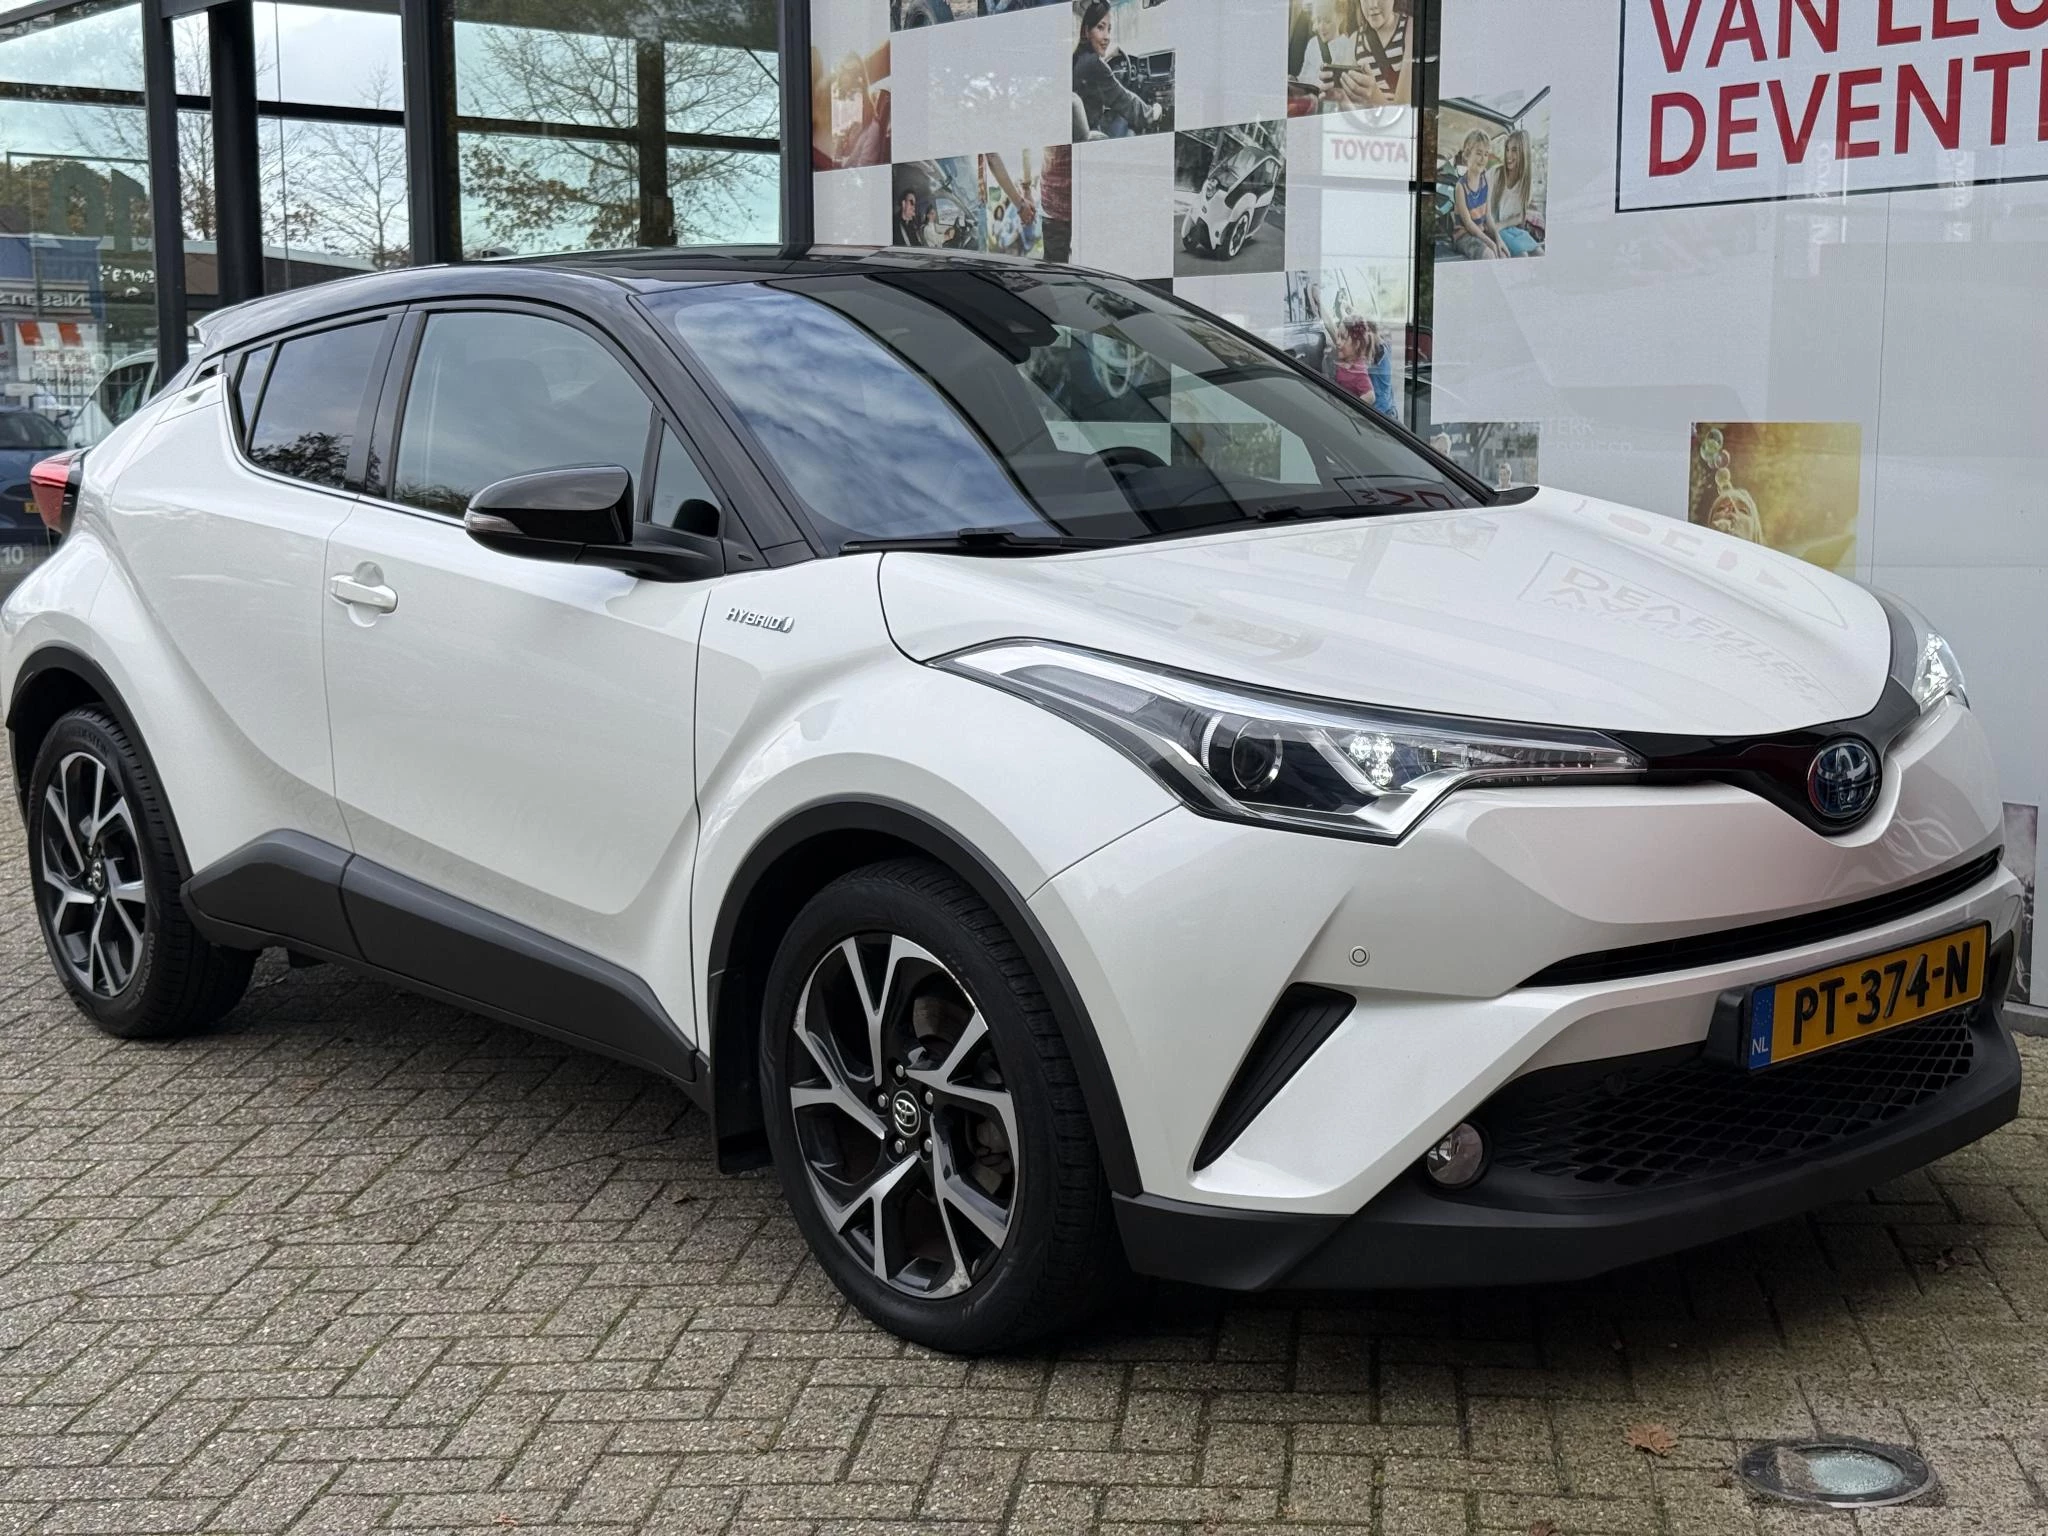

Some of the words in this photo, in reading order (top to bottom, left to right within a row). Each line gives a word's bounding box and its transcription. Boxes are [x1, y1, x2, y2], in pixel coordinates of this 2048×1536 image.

[1649, 0, 1840, 74] VAN
[1648, 48, 2048, 178] DEVENT
[1330, 139, 1410, 163] TOYOTA
[726, 607, 782, 631] HYBRID
[1792, 941, 1971, 1046] PT-374-N
[1751, 1038, 1769, 1055] NL
